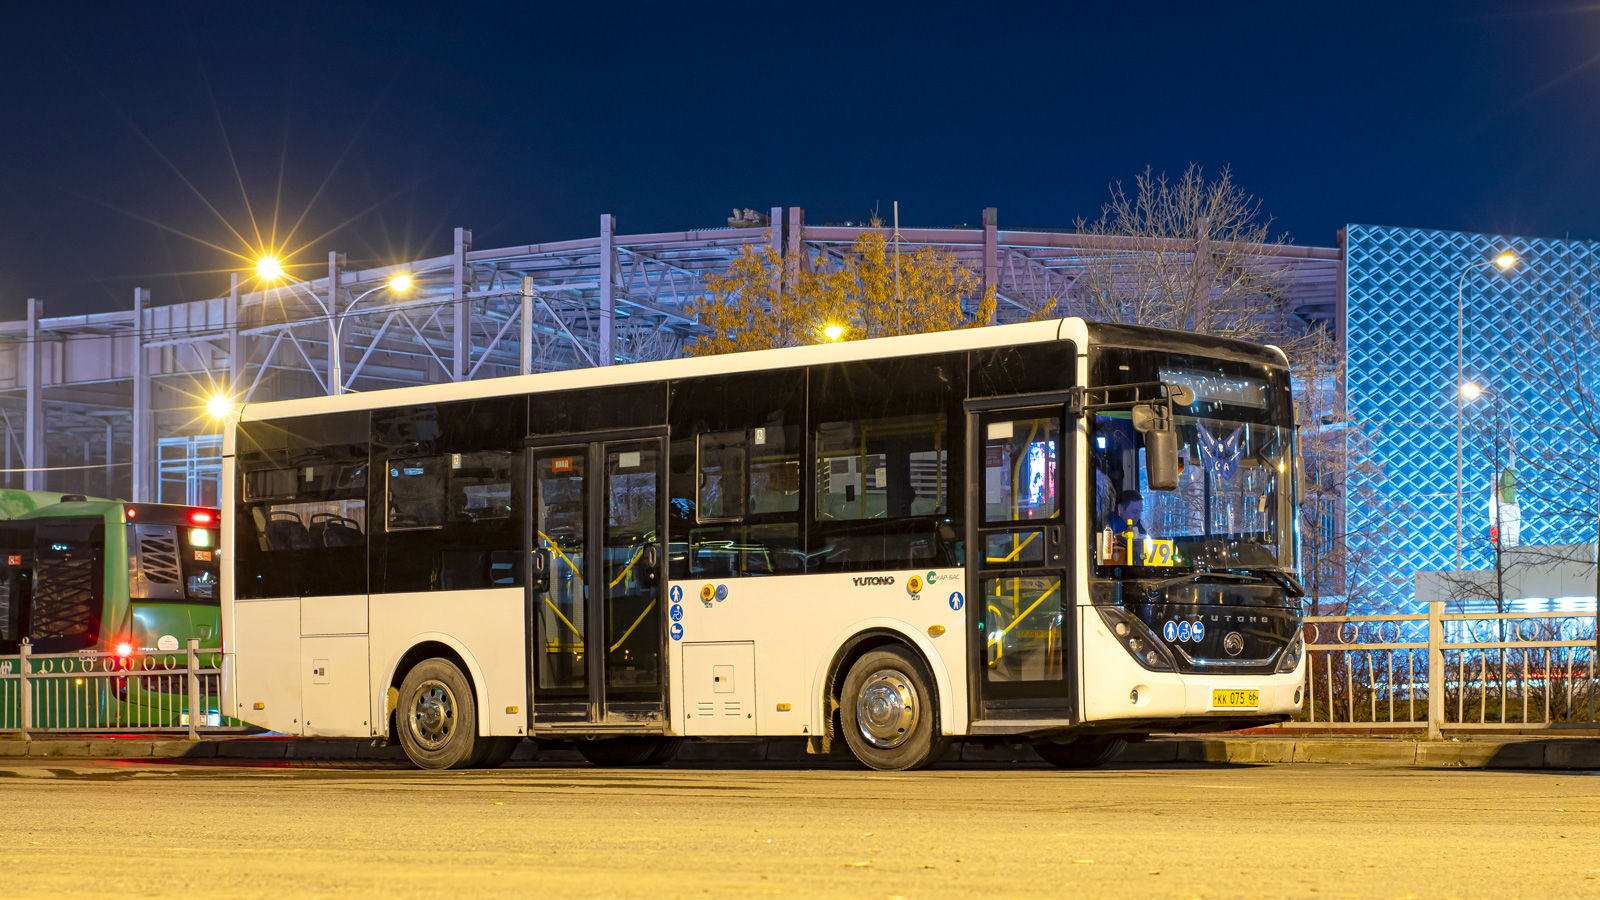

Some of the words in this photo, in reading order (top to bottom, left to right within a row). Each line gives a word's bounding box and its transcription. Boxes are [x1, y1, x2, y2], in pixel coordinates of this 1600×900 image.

[1148, 544, 1170, 564] 79
[853, 576, 895, 586] YUTONG
[1197, 615, 1268, 623] YUTONG
[1230, 692, 1245, 705] 075
[1249, 691, 1256, 701] 66
